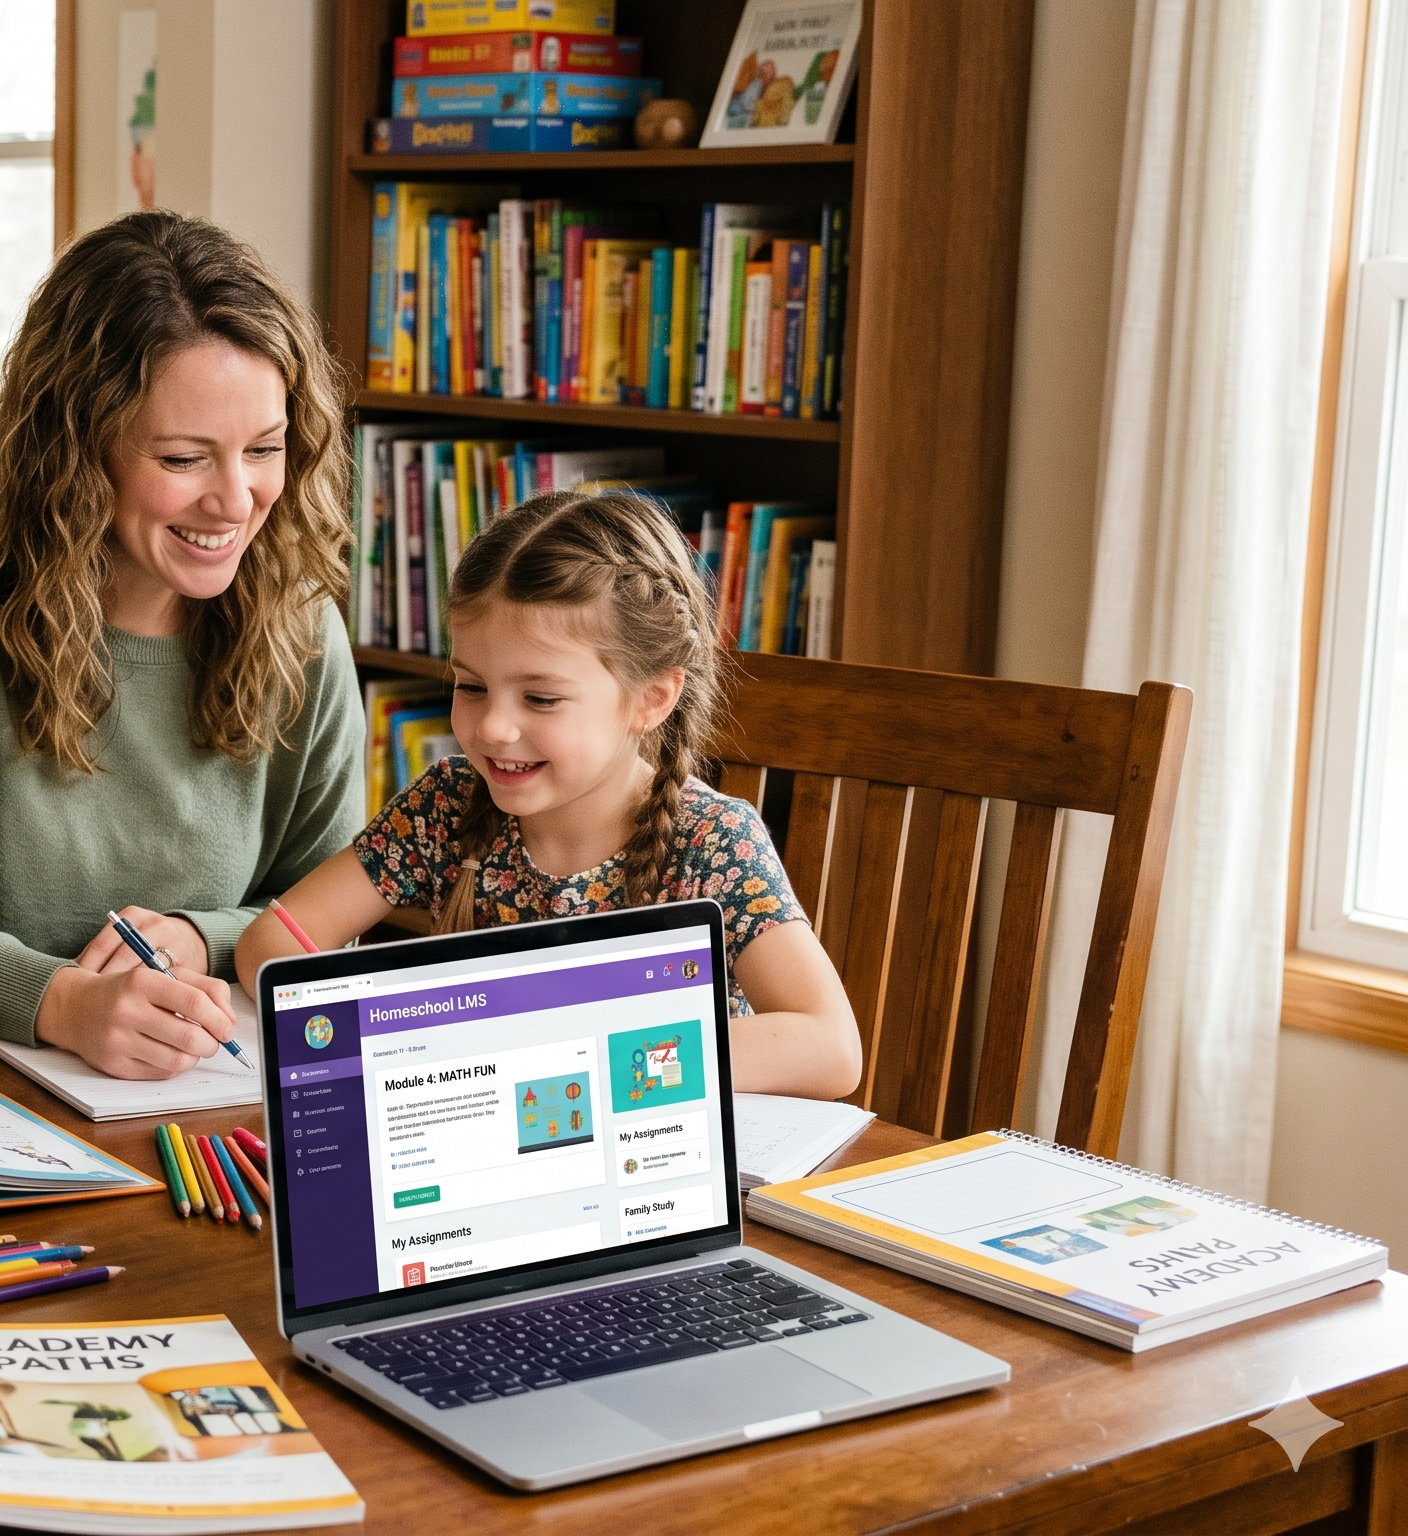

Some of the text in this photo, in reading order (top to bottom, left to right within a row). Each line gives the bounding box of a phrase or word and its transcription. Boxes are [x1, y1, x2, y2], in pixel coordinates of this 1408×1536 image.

[369, 993, 487, 1023] Homeschool LMS
[385, 1064, 496, 1091] Module 4: MATH FUN
[619, 1124, 683, 1143] My Assignments
[624, 1200, 675, 1216] Family Study
[391, 1226, 472, 1250] My Assignments
[1136, 1241, 1302, 1298] ACADEMY
